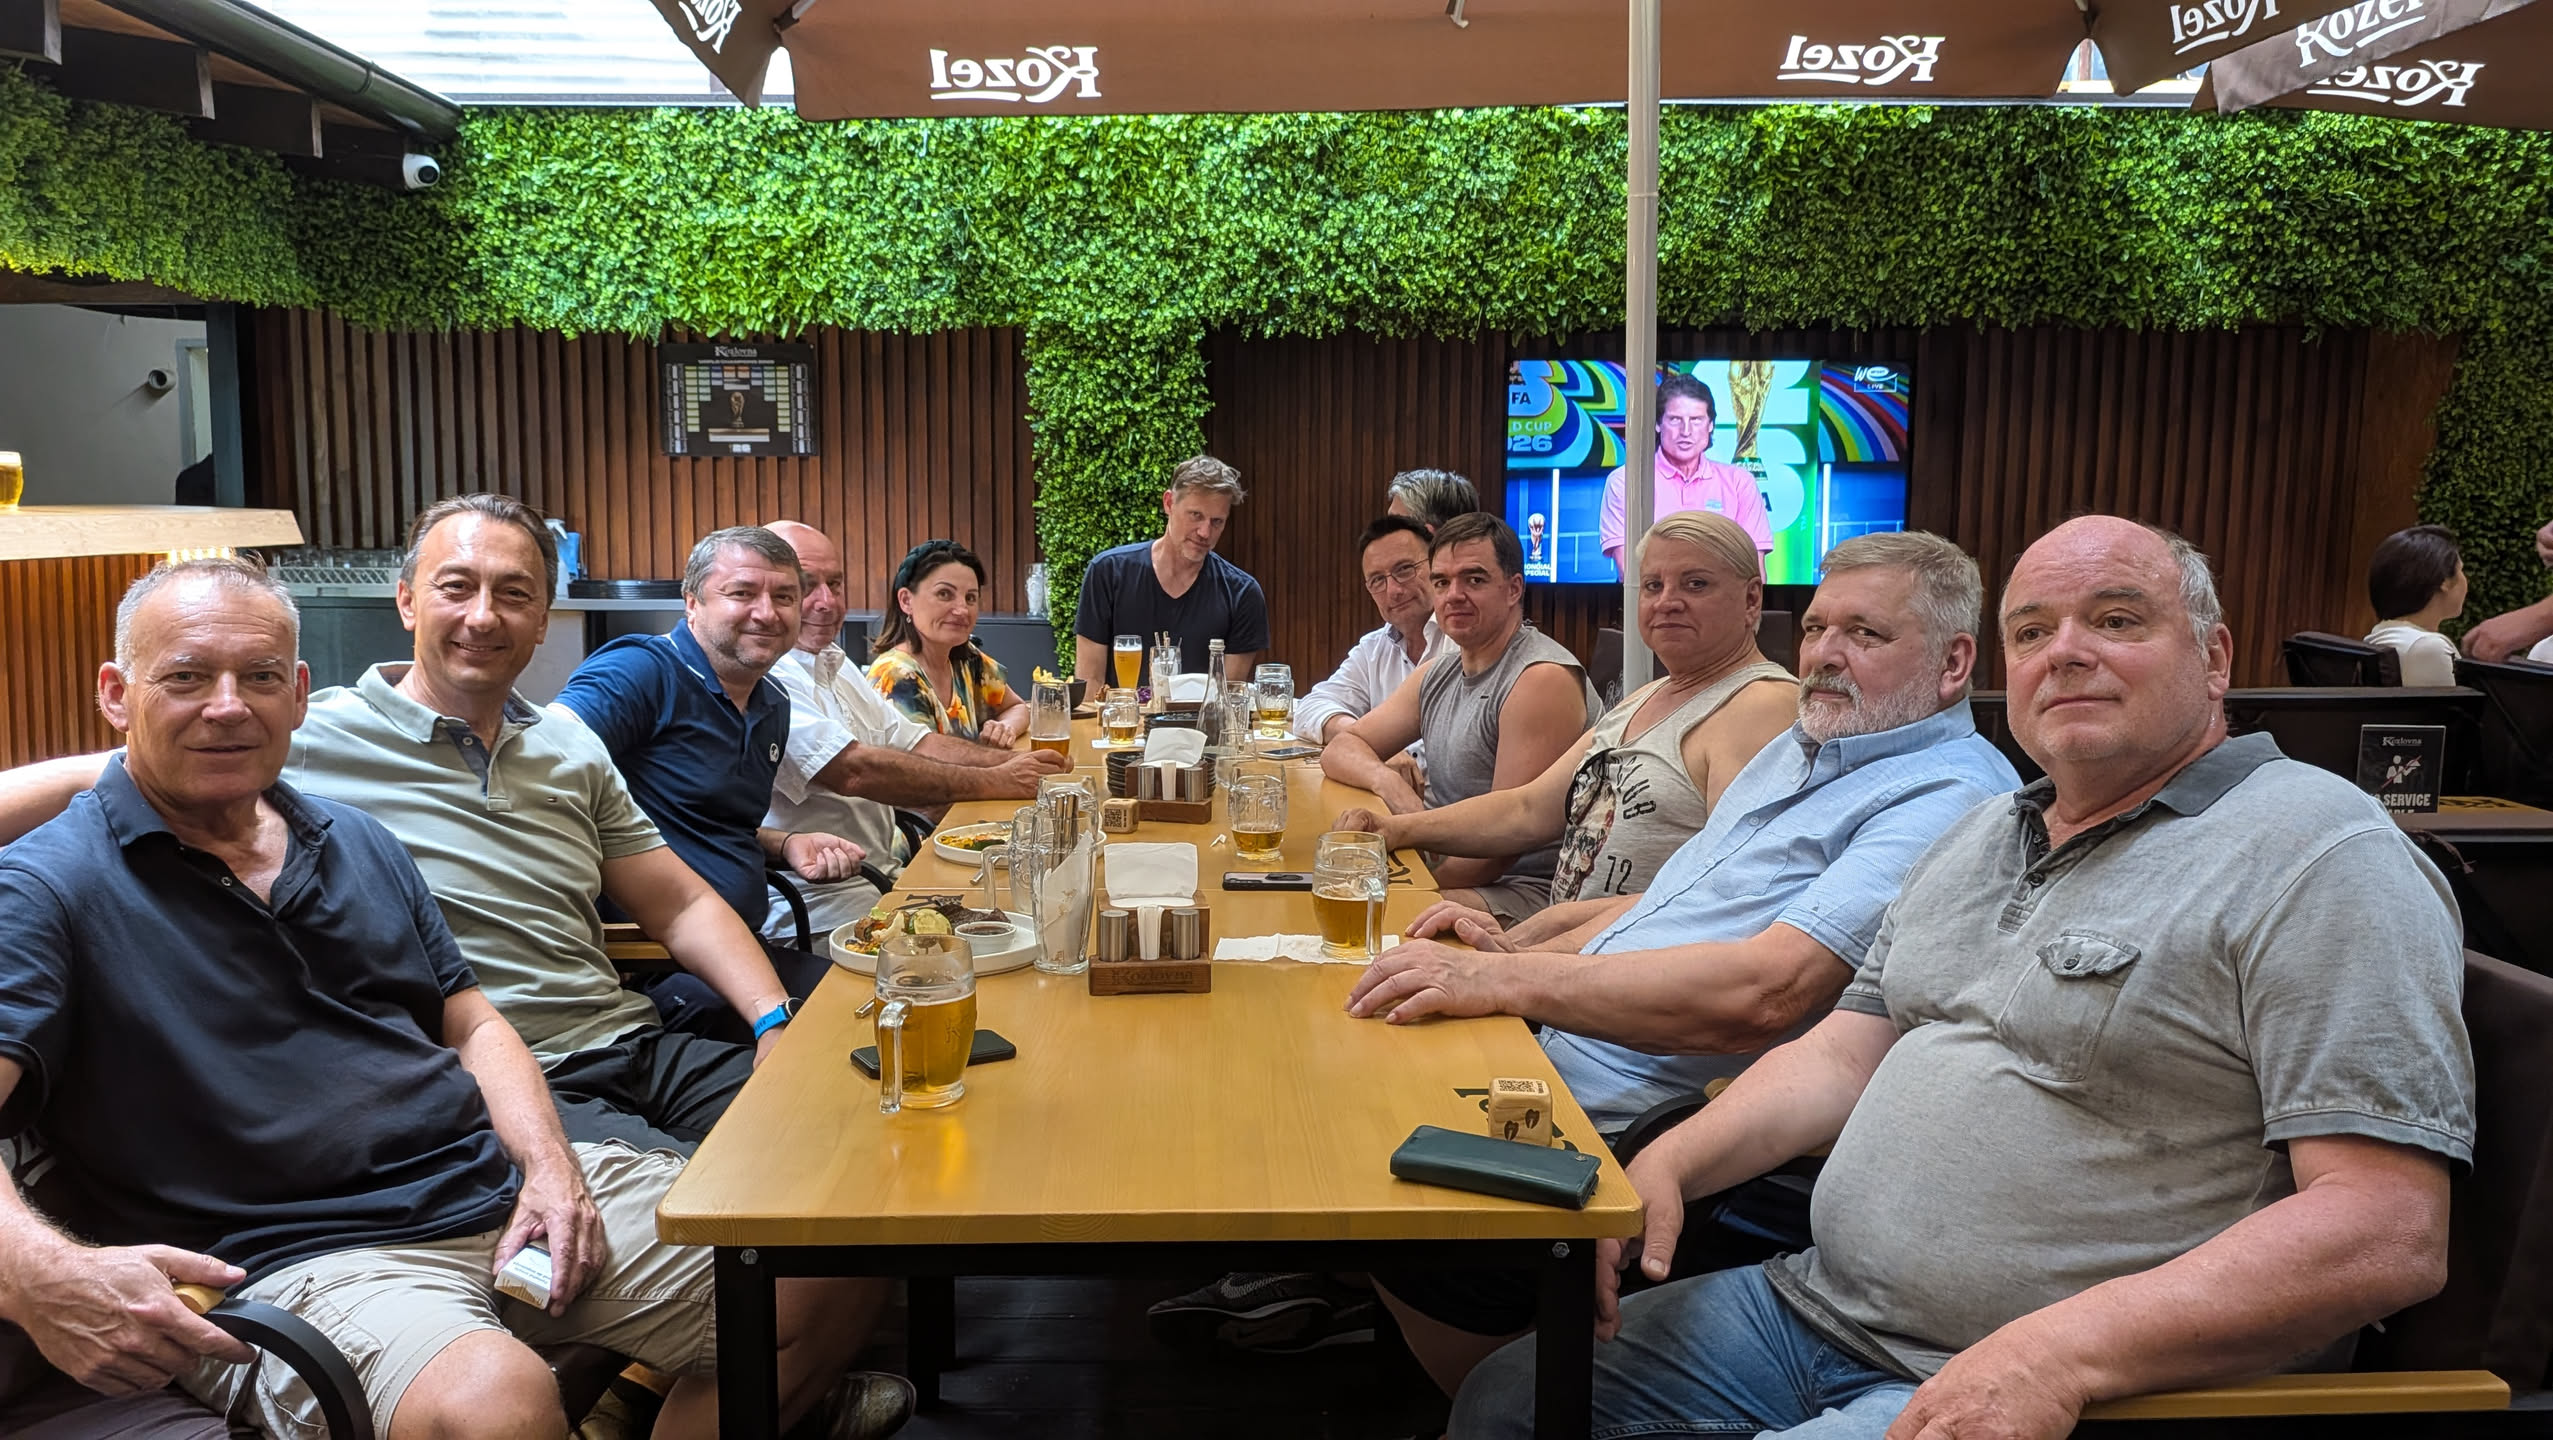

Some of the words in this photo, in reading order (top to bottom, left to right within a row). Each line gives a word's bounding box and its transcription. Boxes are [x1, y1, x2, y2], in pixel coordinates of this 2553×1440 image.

[1511, 392, 1531, 404] FA
[1525, 421, 1552, 432] CUP
[1508, 434, 1552, 452] 26
[2383, 793, 2431, 807] SERVICE
[1604, 855, 1632, 895] 72
